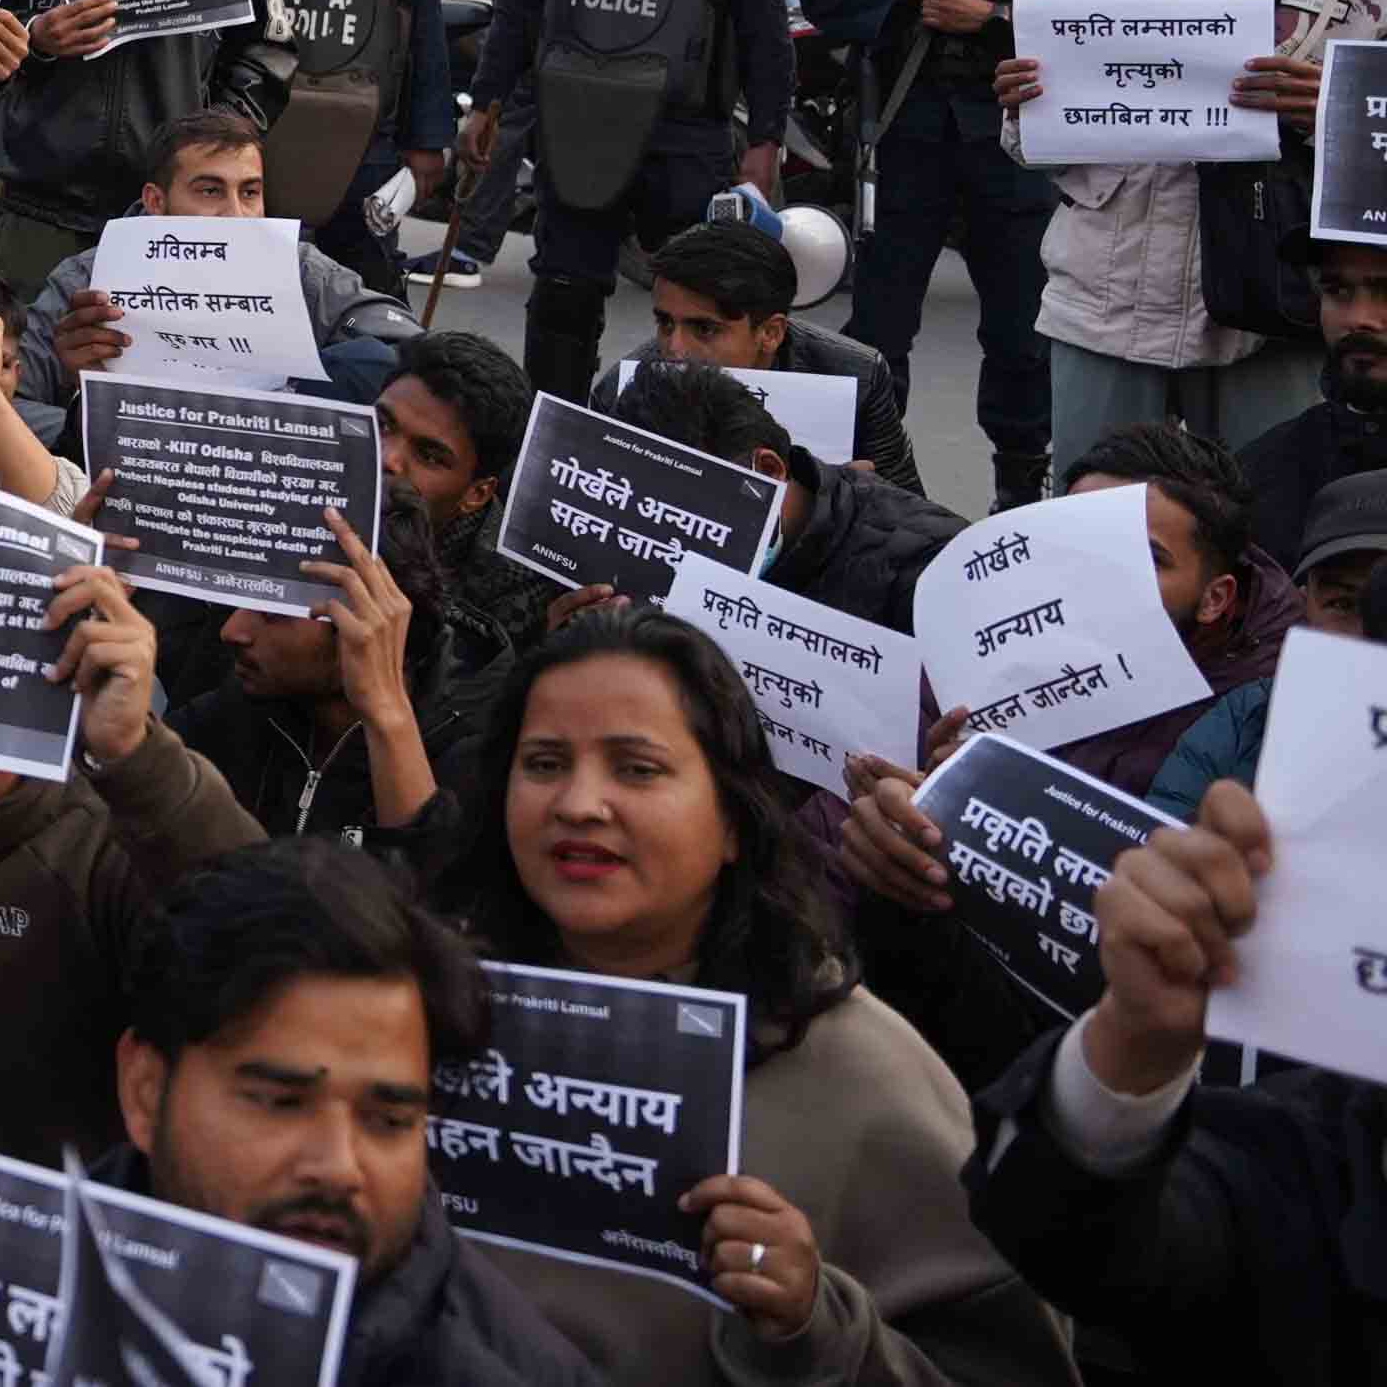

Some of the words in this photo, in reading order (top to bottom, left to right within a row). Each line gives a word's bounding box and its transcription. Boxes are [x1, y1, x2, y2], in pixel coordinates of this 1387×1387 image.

[1051, 13, 1116, 45] प्रकृति
[1121, 13, 1237, 37] लम्सालको
[1104, 59, 1185, 88] मृत्युको
[1064, 102, 1153, 126] छानबिन
[1160, 109, 1193, 126] गर
[1206, 107, 1228, 126] !!!
[145, 234, 228, 261] अविलम्ब
[204, 293, 274, 314] सम्बाद
[189, 335, 220, 351] गर
[117, 400, 176, 420] Justice
[179, 407, 204, 423] for
[208, 411, 270, 431] Prakriti
[274, 418, 334, 438] Lamsal
[165, 440, 198, 456] -KIIT
[201, 444, 253, 462] Odisha
[602, 432, 631, 450] Justice
[631, 443, 644, 455] for
[644, 448, 675, 467] Prakriti
[674, 460, 703, 476] Lamsal
[114, 469, 151, 483] Protect
[153, 475, 204, 491] Nepalese
[207, 482, 257, 497] students
[259, 488, 308, 506] studying
[311, 496, 323, 506] at
[325, 497, 348, 509] KIIT
[178, 493, 216, 508] Odisha
[218, 497, 276, 515] University
[548, 456, 633, 511] गोर्खेले
[637, 495, 732, 548] अन्याय
[135, 517, 191, 538] Investigate
[192, 526, 211, 539] the
[213, 531, 273, 549] suspicious
[275, 539, 308, 554] death
[310, 544, 323, 555] of
[183, 540, 223, 556] Prakriti
[225, 547, 268, 563] Lamsal.
[549, 499, 614, 543] सहन
[617, 526, 688, 566] जान्दै
[155, 563, 202, 581] ANNFSU
[532, 541, 578, 571] ANNFSU
[964, 531, 1031, 582] गोर्खेले
[702, 588, 762, 630] प्रकृति
[767, 614, 883, 675] लम्सालको
[975, 598, 1065, 657] अन्याय
[742, 661, 823, 709] मृत्युको
[967, 693, 1027, 733] सहन
[1025, 663, 1109, 710] जान्दैन
[1117, 653, 1133, 680] !
[799, 732, 832, 762] गर
[961, 796, 1053, 864] प्रकृति
[1043, 785, 1081, 810] Justice
[1081, 802, 1098, 817] for
[1098, 813, 1140, 841] Prakriti
[948, 840, 1054, 917] मृत्युको
[1038, 932, 1082, 974] गर
[512, 993, 560, 1013] Prakriti
[560, 997, 610, 1020] Lamsal
[524, 1071, 682, 1135] अन्याय
[509, 1132, 658, 1197] जान्दैन
